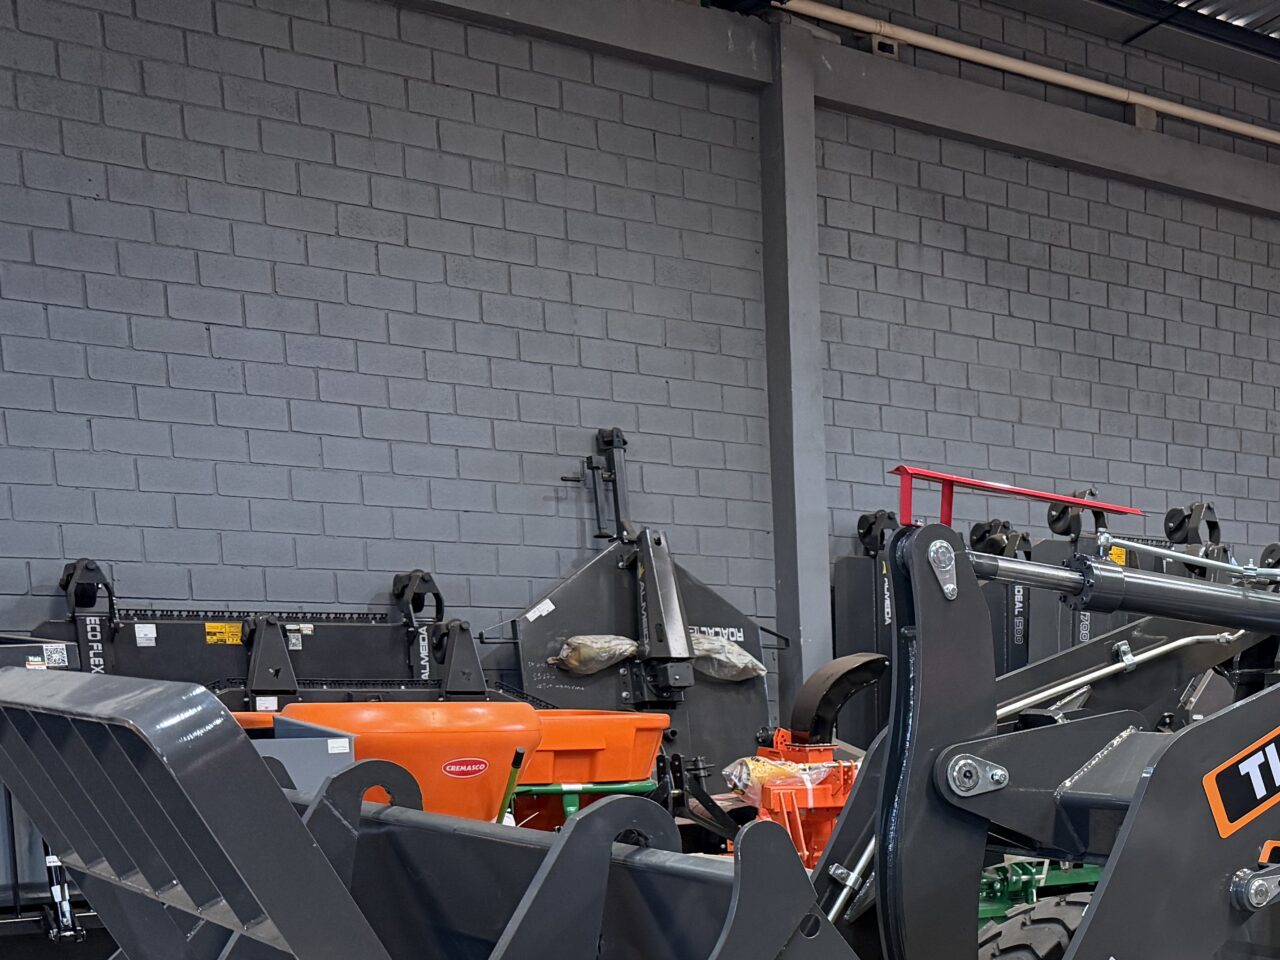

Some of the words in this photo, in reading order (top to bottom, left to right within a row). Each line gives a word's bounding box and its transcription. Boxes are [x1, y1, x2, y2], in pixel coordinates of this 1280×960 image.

[1014, 585, 1024, 615] IDEAL
[86, 616, 102, 640] ECO
[639, 580, 651, 656] ALMEIDA
[1080, 611, 1091, 642] 700
[88, 642, 105, 674] FLEX
[417, 625, 430, 680] ALMEIDA
[445, 763, 486, 772] CREMASCO
